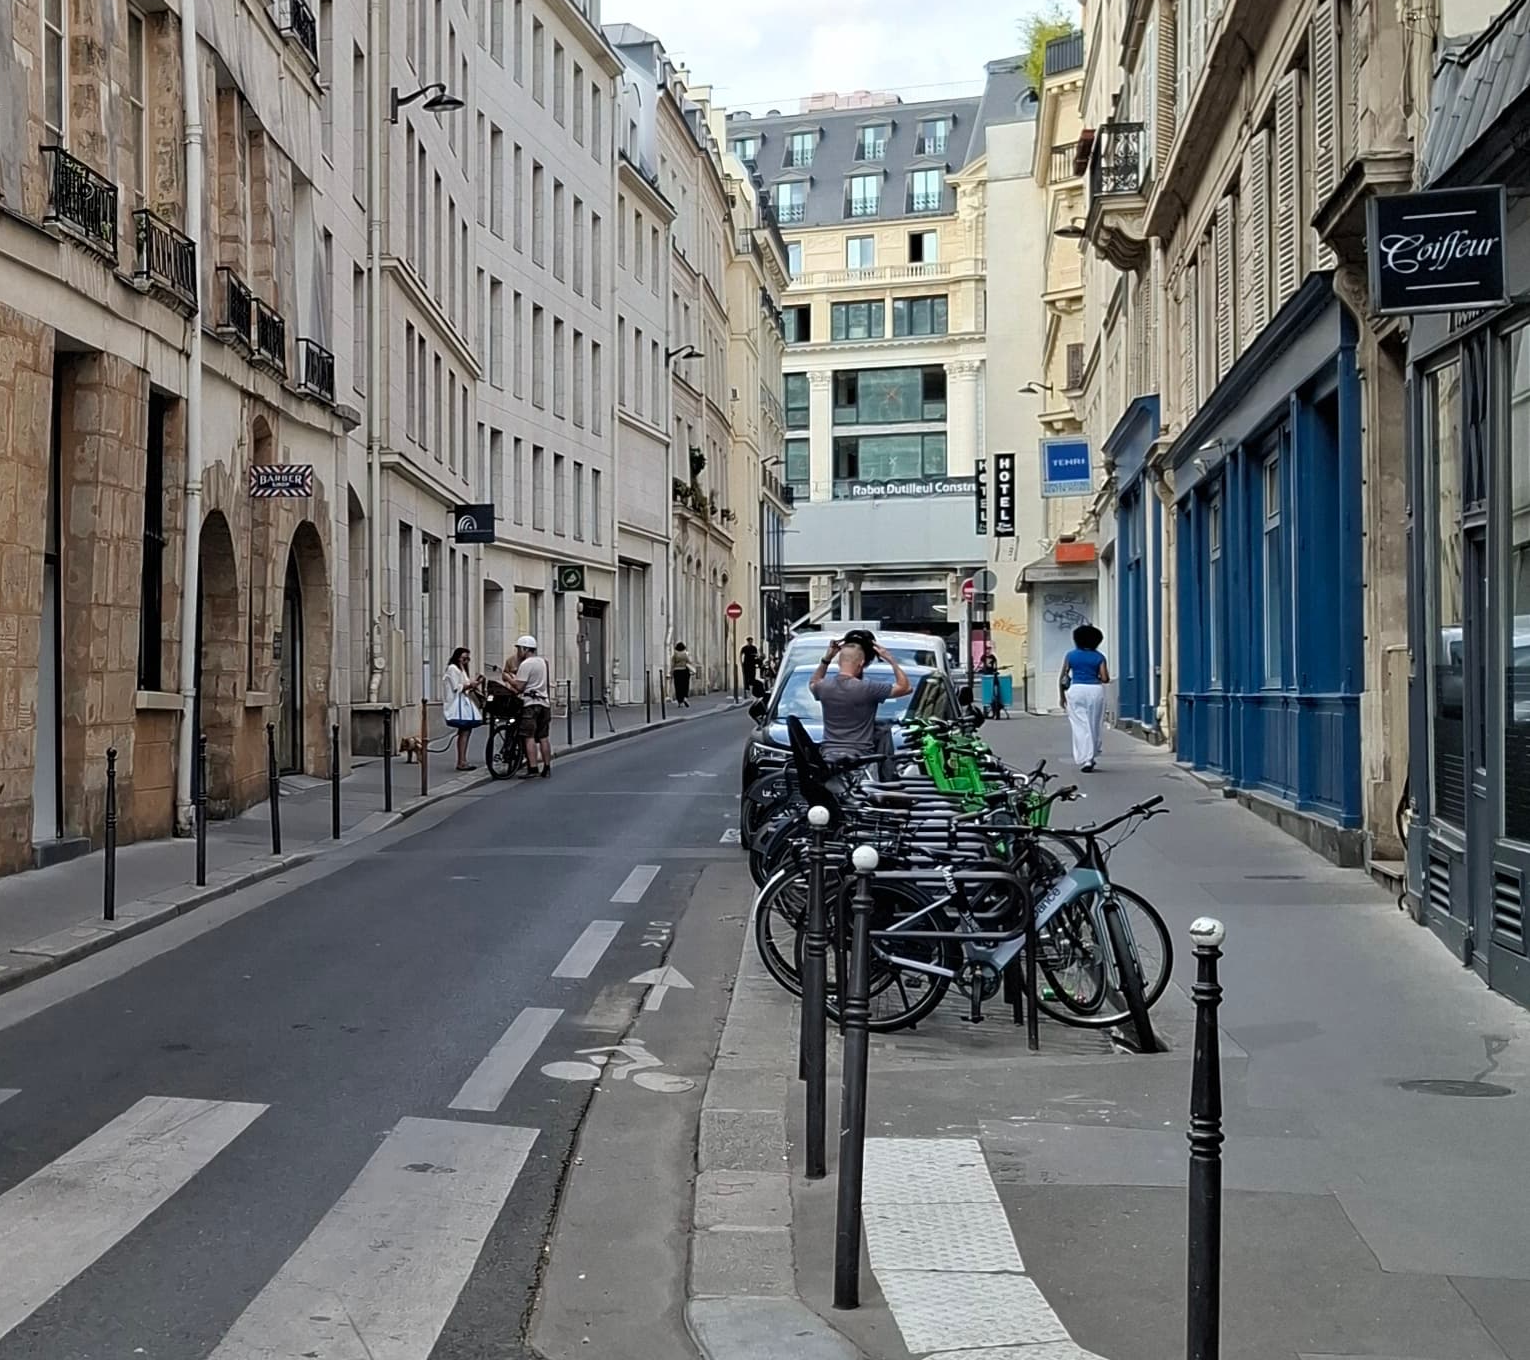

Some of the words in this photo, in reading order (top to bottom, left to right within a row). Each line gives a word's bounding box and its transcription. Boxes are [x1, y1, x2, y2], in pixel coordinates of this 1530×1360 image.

[1380, 230, 1499, 274] Coiffeur
[260, 475, 302, 485] BARBER
[853, 484, 885, 496] Rabot
[886, 482, 933, 494] Dutilleul
[999, 458, 1010, 520] HOTEL
[1035, 887, 1062, 918] ance
